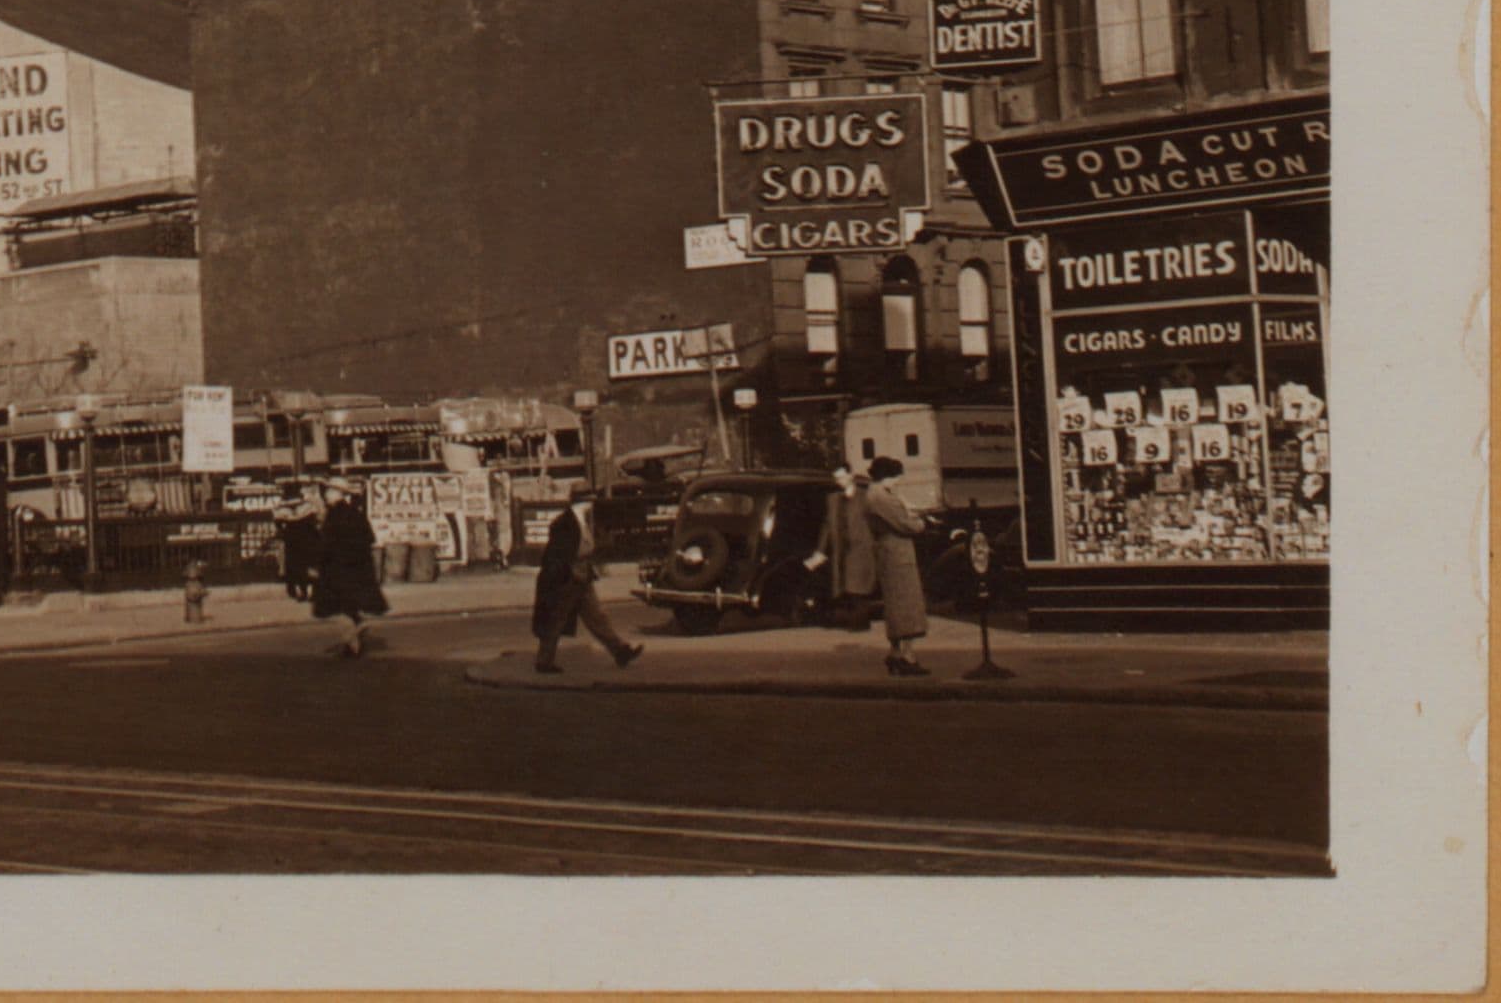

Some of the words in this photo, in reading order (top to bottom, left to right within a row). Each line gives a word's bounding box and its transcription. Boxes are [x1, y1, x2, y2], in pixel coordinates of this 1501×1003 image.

[937, 19, 1033, 53] DENTIST
[738, 111, 905, 151] DRUGS
[1041, 139, 1187, 179] SODA
[1201, 126, 1278, 155] CUT
[761, 162, 889, 201] SODA
[1089, 153, 1308, 200] LUNCHEON
[752, 217, 900, 249] CIGARS
[1058, 240, 1237, 290] TOILETRIES
[1063, 328, 1147, 353] CIGARS
[1159, 321, 1242, 347] CANDY
[1265, 321, 1317, 342] FILMS
[1169, 405, 1190, 421] 16
[1090, 446, 1109, 462] 16
[1144, 443, 1160, 458] 9
[1201, 441, 1221, 457] 16
